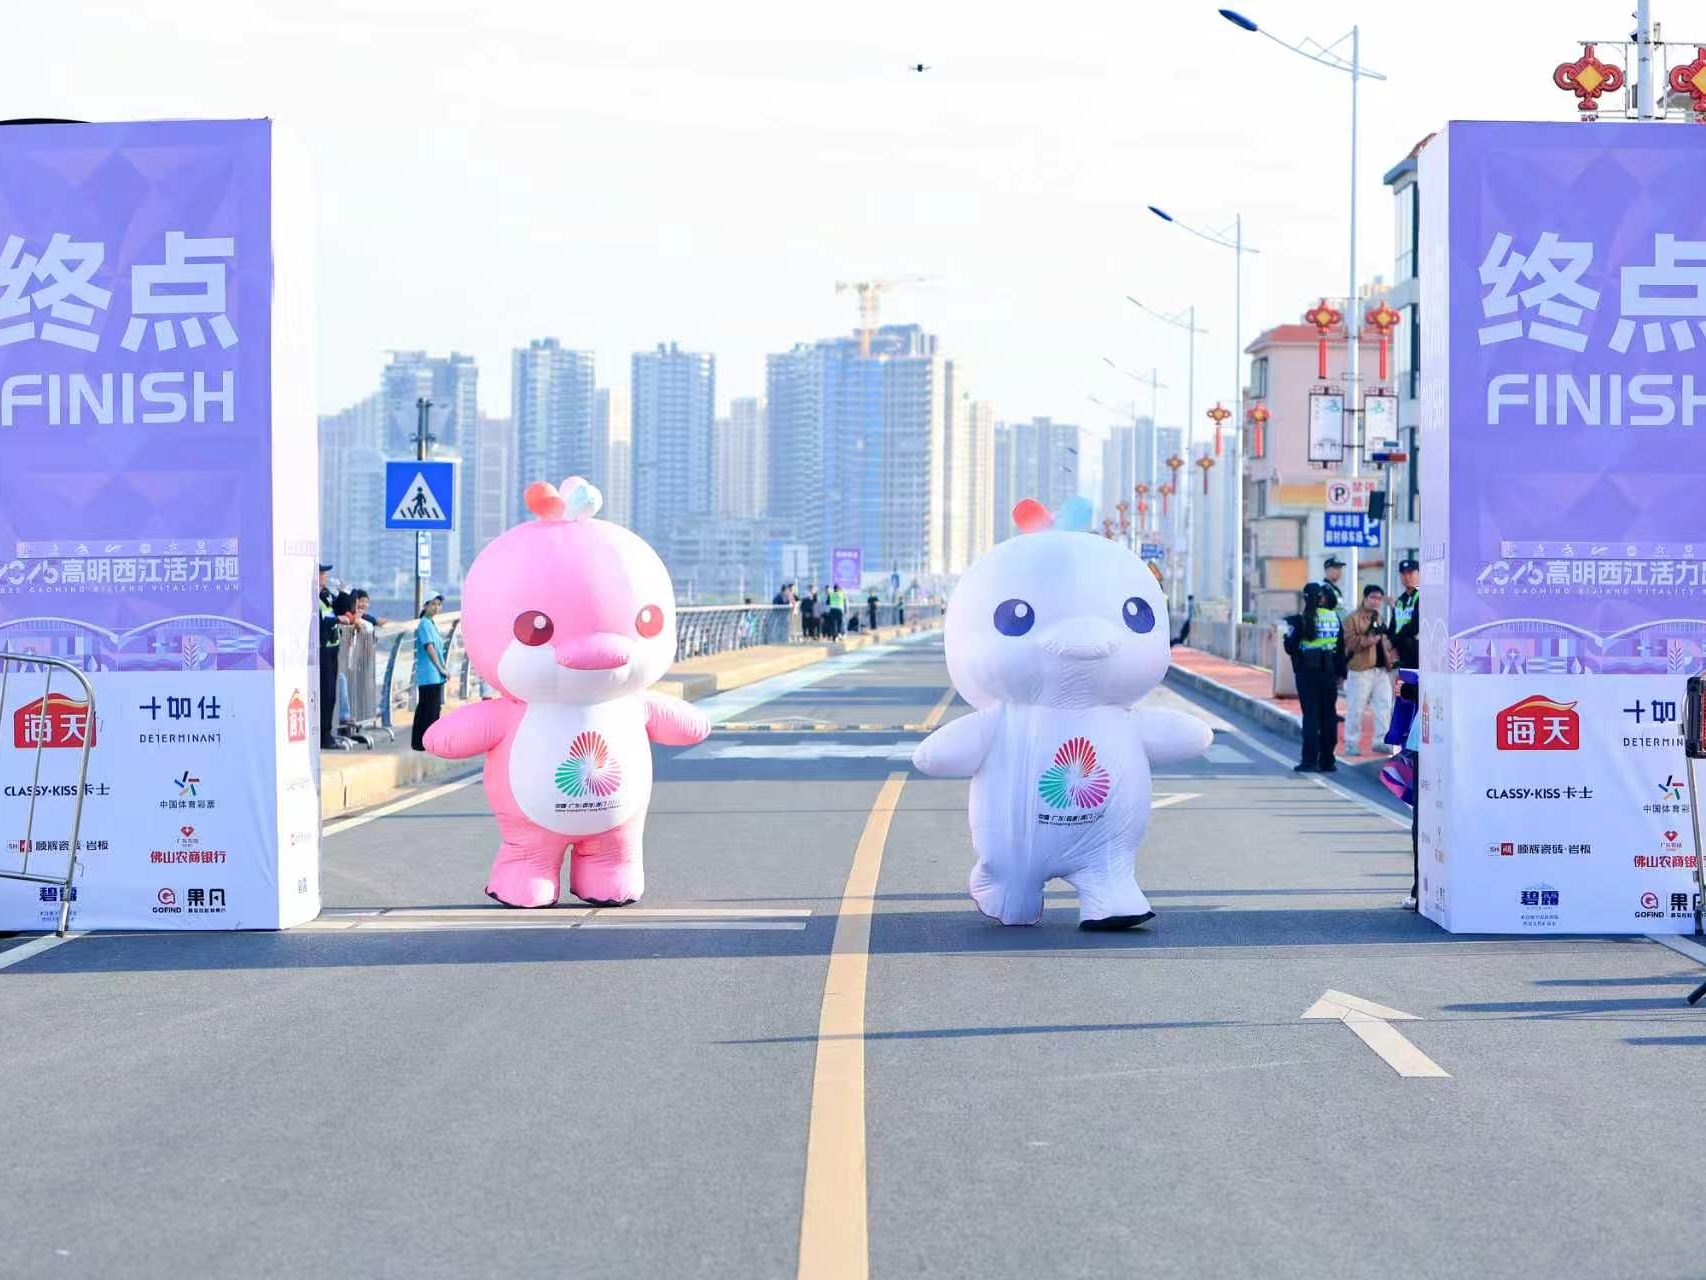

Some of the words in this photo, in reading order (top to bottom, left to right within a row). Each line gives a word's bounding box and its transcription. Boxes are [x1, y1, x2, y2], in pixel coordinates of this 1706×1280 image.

[0, 231, 239, 352] 终点
[1478, 231, 1706, 353] 终点
[1, 370, 235, 426] FINISH
[1487, 373, 1706, 426] FINISH
[1476, 560, 1706, 586] 2025高明西江活力
[24, 713, 87, 743] 海天
[1507, 715, 1571, 745] 海天
[160, 799, 215, 809] 中国体育彩票
[1562, 786, 1593, 799] 卡士
[1643, 804, 1692, 814] 中国体育彩
[150, 850, 226, 864] 佛山农商银行
[1634, 911, 1665, 919] GOFIND
